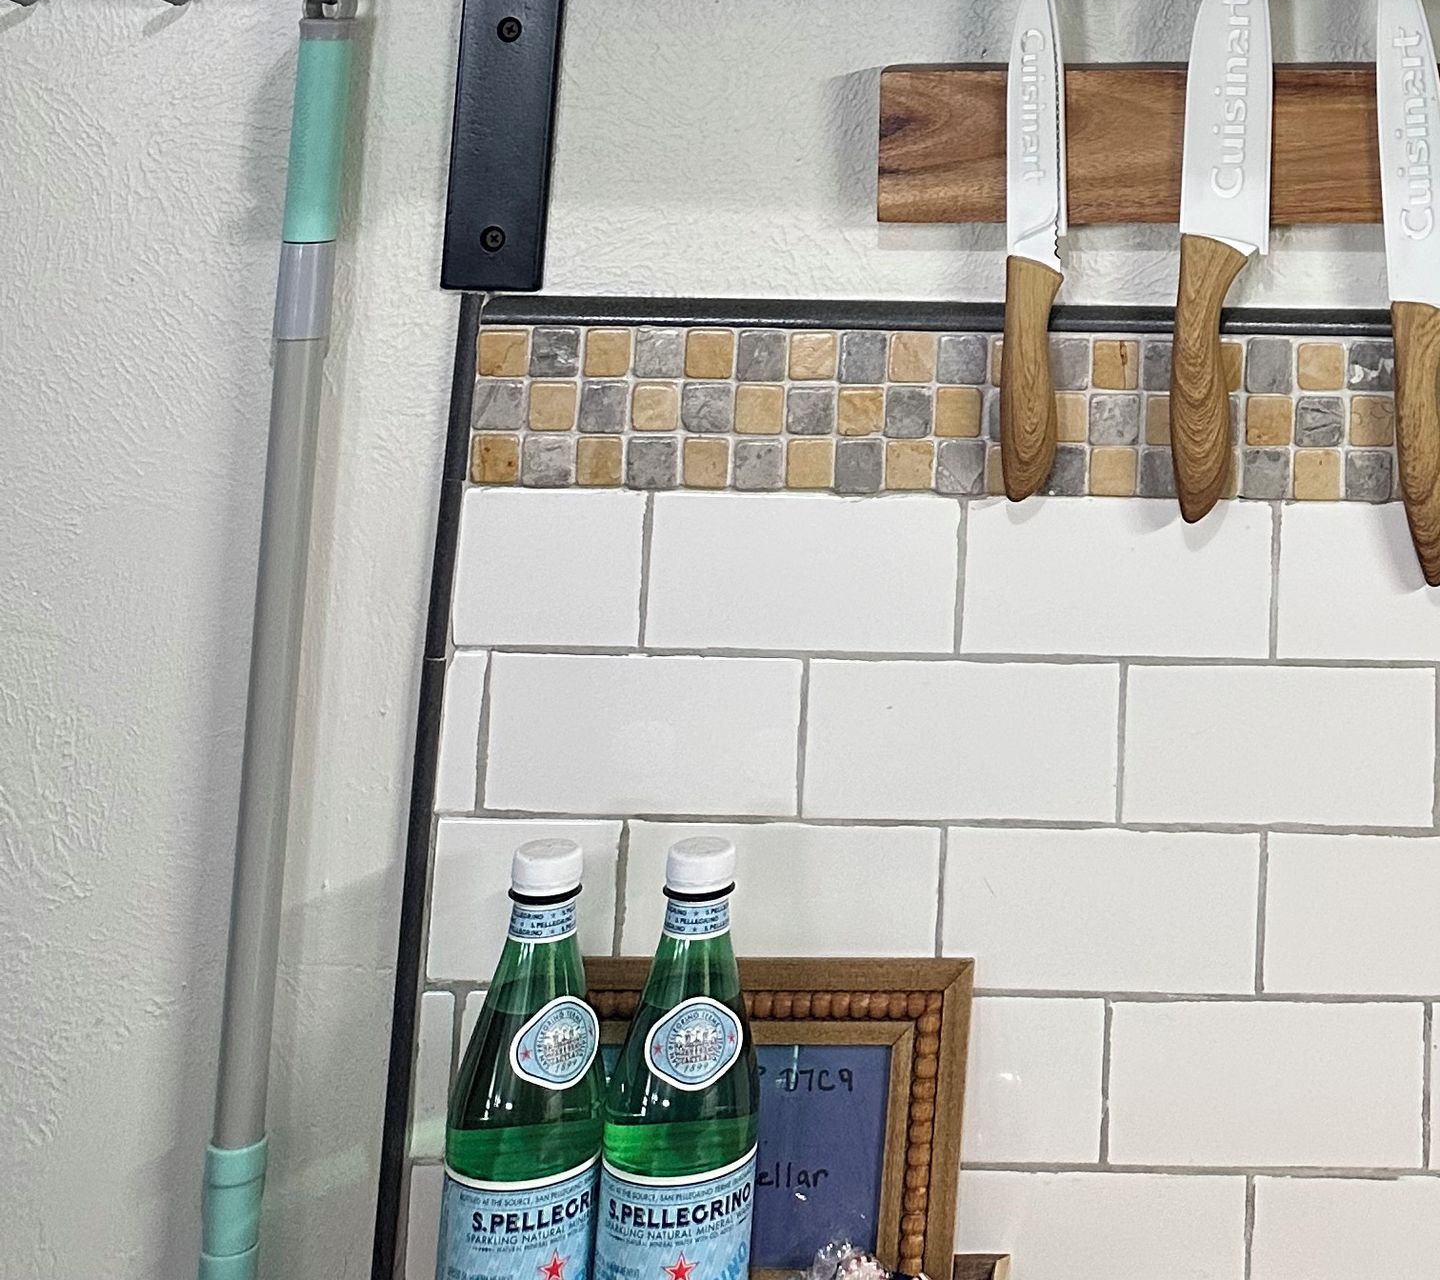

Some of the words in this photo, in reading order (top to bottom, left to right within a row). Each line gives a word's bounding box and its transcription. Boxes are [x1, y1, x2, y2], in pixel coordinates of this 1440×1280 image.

[1020, 28, 1047, 183] Cuisinart
[1391, 26, 1435, 241] Cuisinart
[608, 1182, 751, 1230] S.PELLEGRINO
[647, 1229, 692, 1241] NATURAL
[695, 1215, 734, 1236] MINERAL
[466, 1232, 518, 1246] SPARKLING
[521, 1224, 566, 1243] NATURAL
